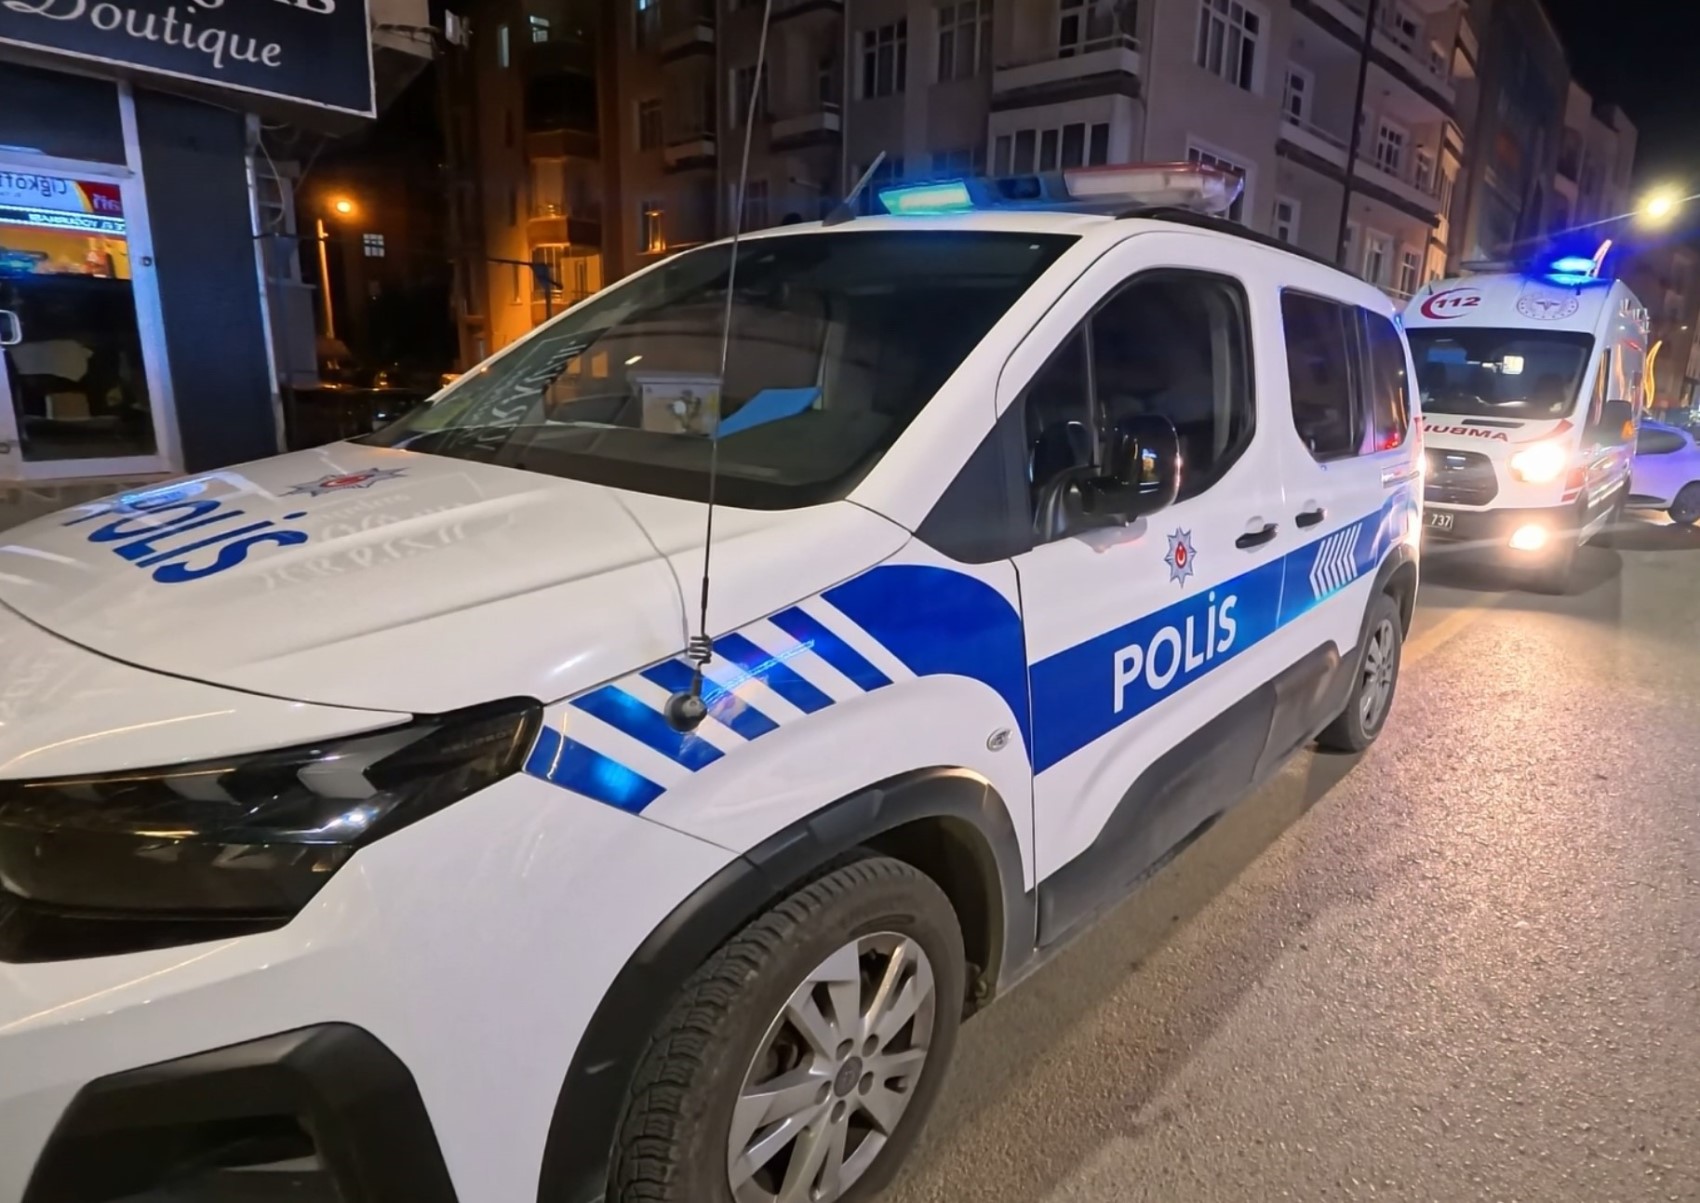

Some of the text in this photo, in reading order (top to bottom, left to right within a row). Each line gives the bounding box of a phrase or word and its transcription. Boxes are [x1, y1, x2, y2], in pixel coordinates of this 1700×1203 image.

[1435, 296, 1481, 309] 112
[1431, 513, 1451, 528] 737
[1113, 590, 1238, 714] POLİS
